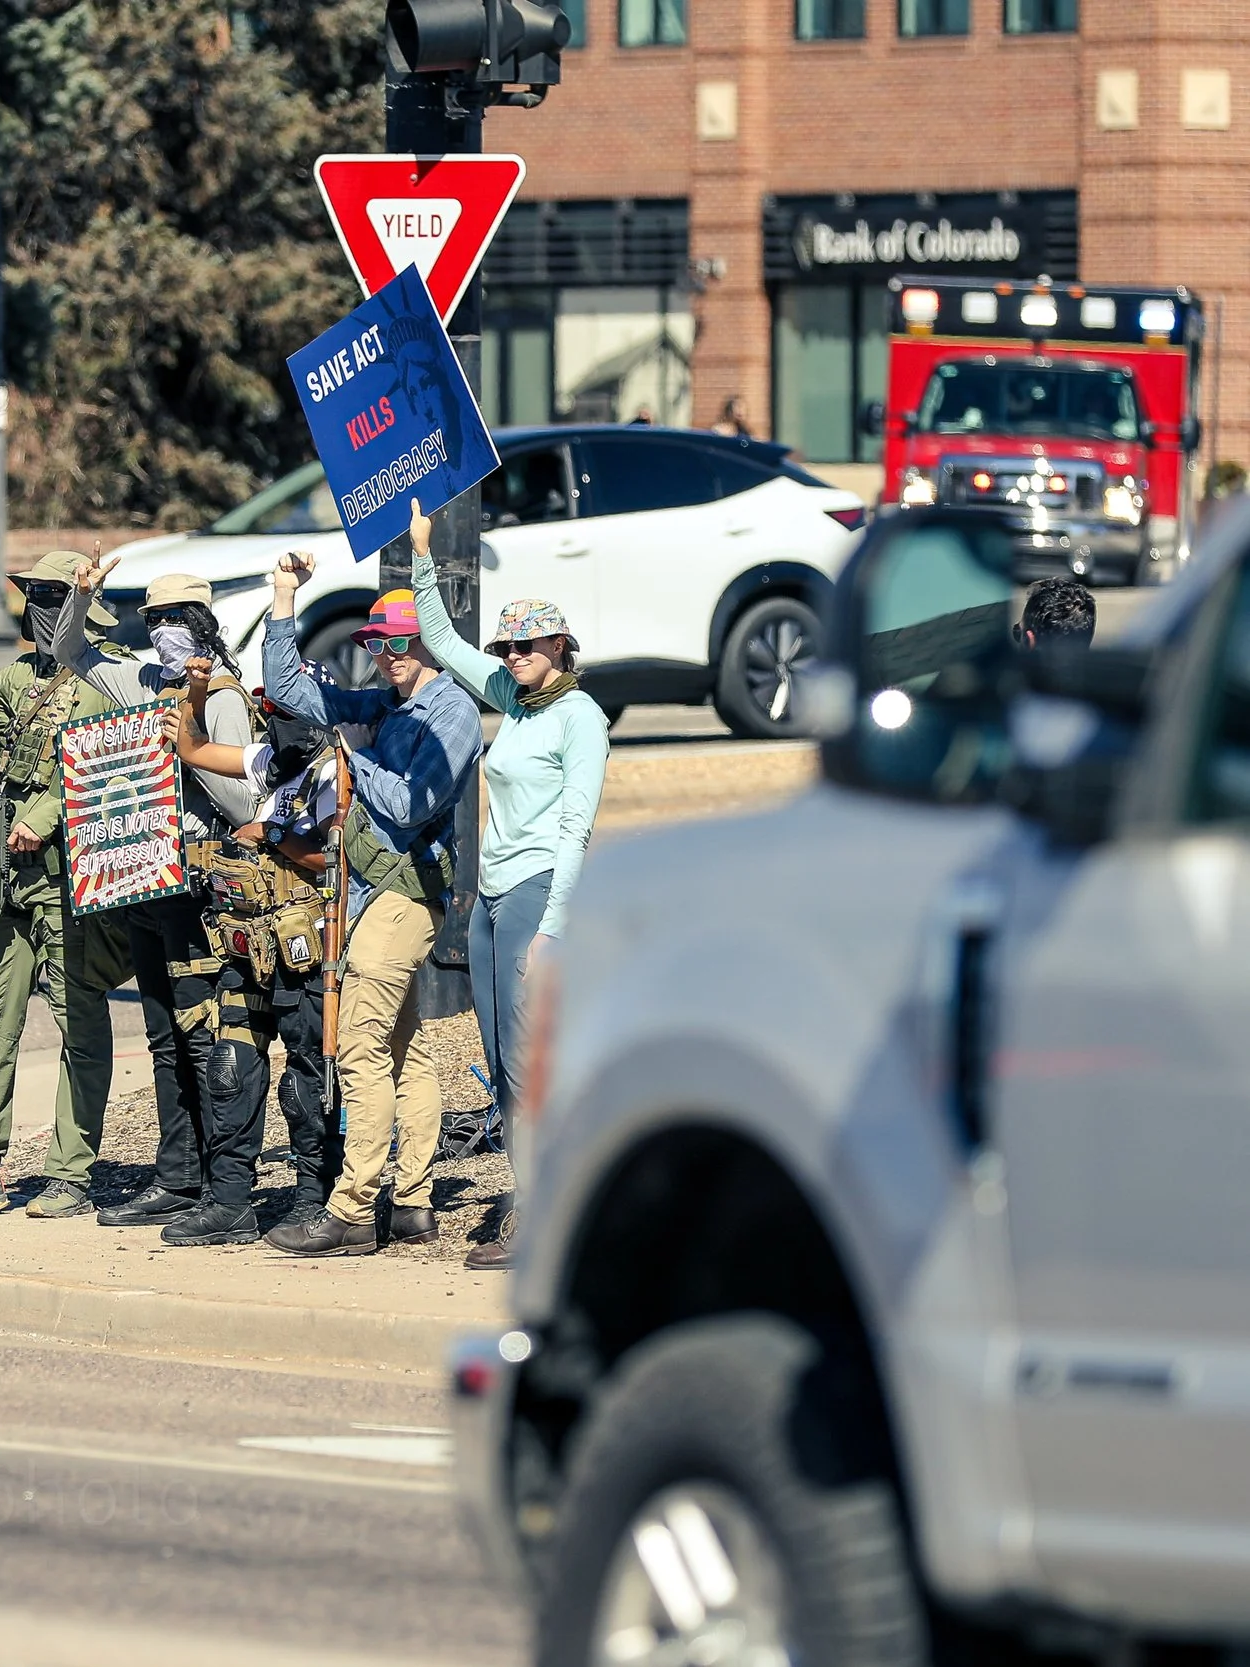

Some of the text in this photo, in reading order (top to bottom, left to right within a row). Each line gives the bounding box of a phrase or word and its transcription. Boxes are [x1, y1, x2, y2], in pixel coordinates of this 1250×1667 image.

[383, 214, 442, 238] YIELD
[814, 217, 1020, 263] Bank of Colorado
[306, 324, 385, 402] SAVE ACT
[346, 397, 395, 451] KILLS
[341, 429, 448, 527] DEMOCRACY
[66, 714, 163, 755] STOP SAVE AC
[76, 805, 170, 847] THIS IS VOTER
[77, 836, 174, 877] SUPPRESSION
